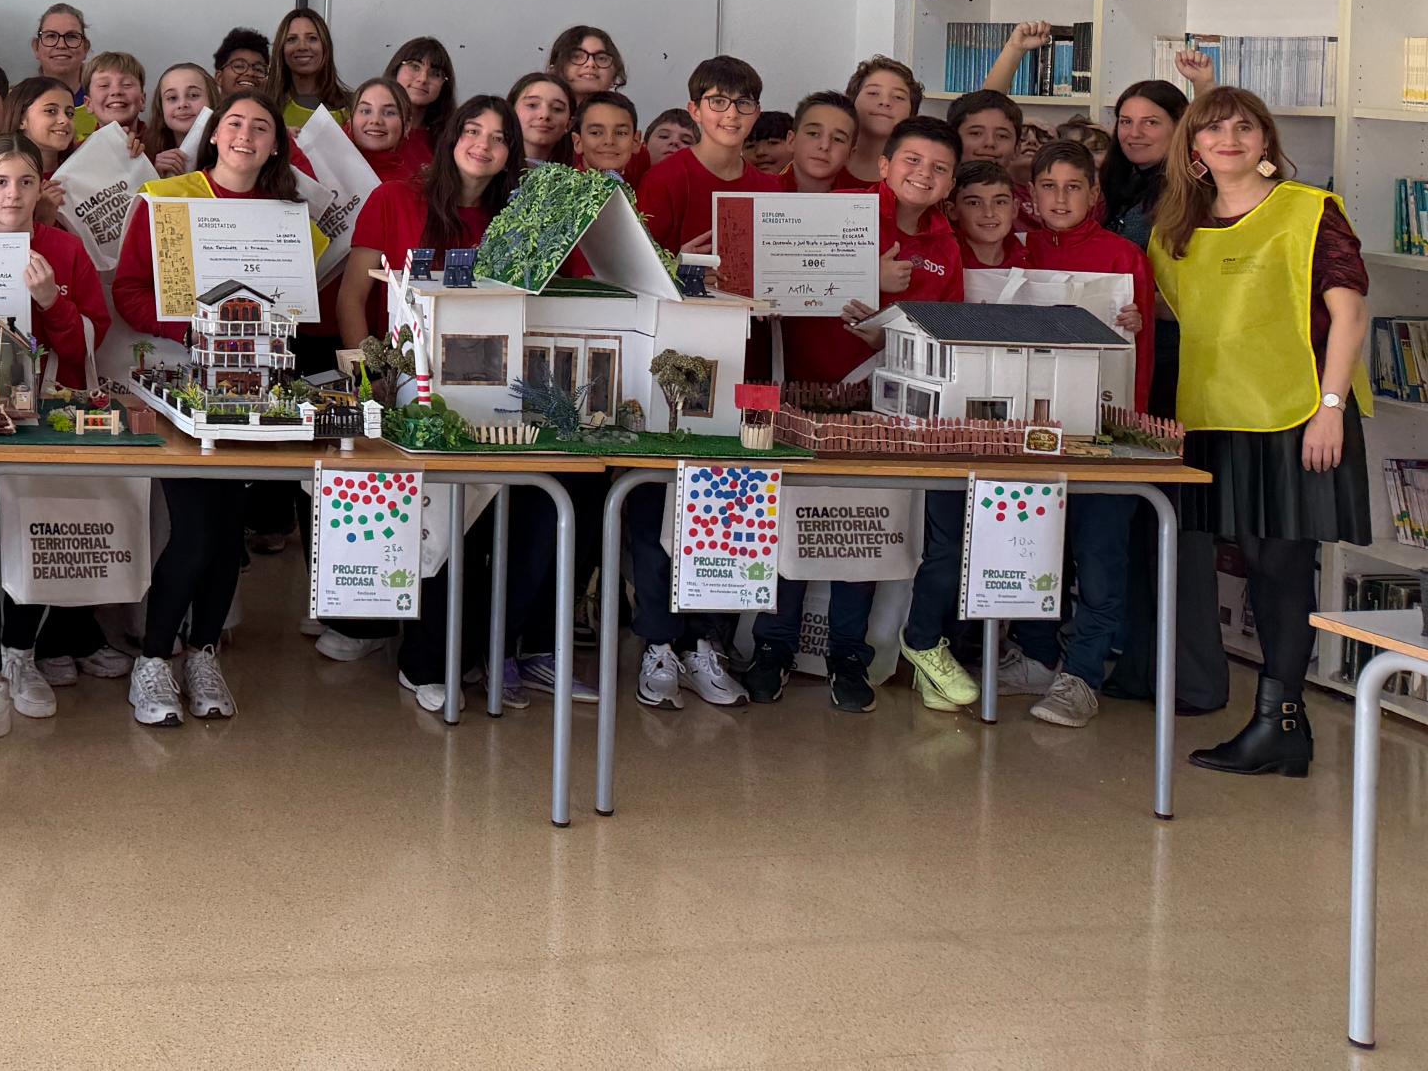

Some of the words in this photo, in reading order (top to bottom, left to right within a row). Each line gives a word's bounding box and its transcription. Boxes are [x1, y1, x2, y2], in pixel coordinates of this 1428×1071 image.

[244, 264, 261, 273] 25€
[802, 259, 826, 268] 100€
[923, 259, 945, 276] SDS
[796, 507, 889, 519] CTAACOLEGIO
[30, 523, 114, 535] CTAACOLEGIO
[796, 520, 885, 532] TERRITORIAL
[30, 537, 111, 550] TERRITORIAL
[798, 532, 904, 546] DEARQUITECTOS
[32, 550, 131, 565] DEARQUITECTOS
[798, 547, 882, 558] DEALICANTE
[693, 557, 737, 567] PROJECTE
[33, 566, 108, 579] DEALICANTE
[332, 564, 378, 575] PROJECTE
[696, 568, 733, 578] ECOCASA
[982, 569, 1027, 579] PROJECTE
[335, 577, 374, 586] ECOCASA
[985, 581, 1022, 590] ECOCASA
